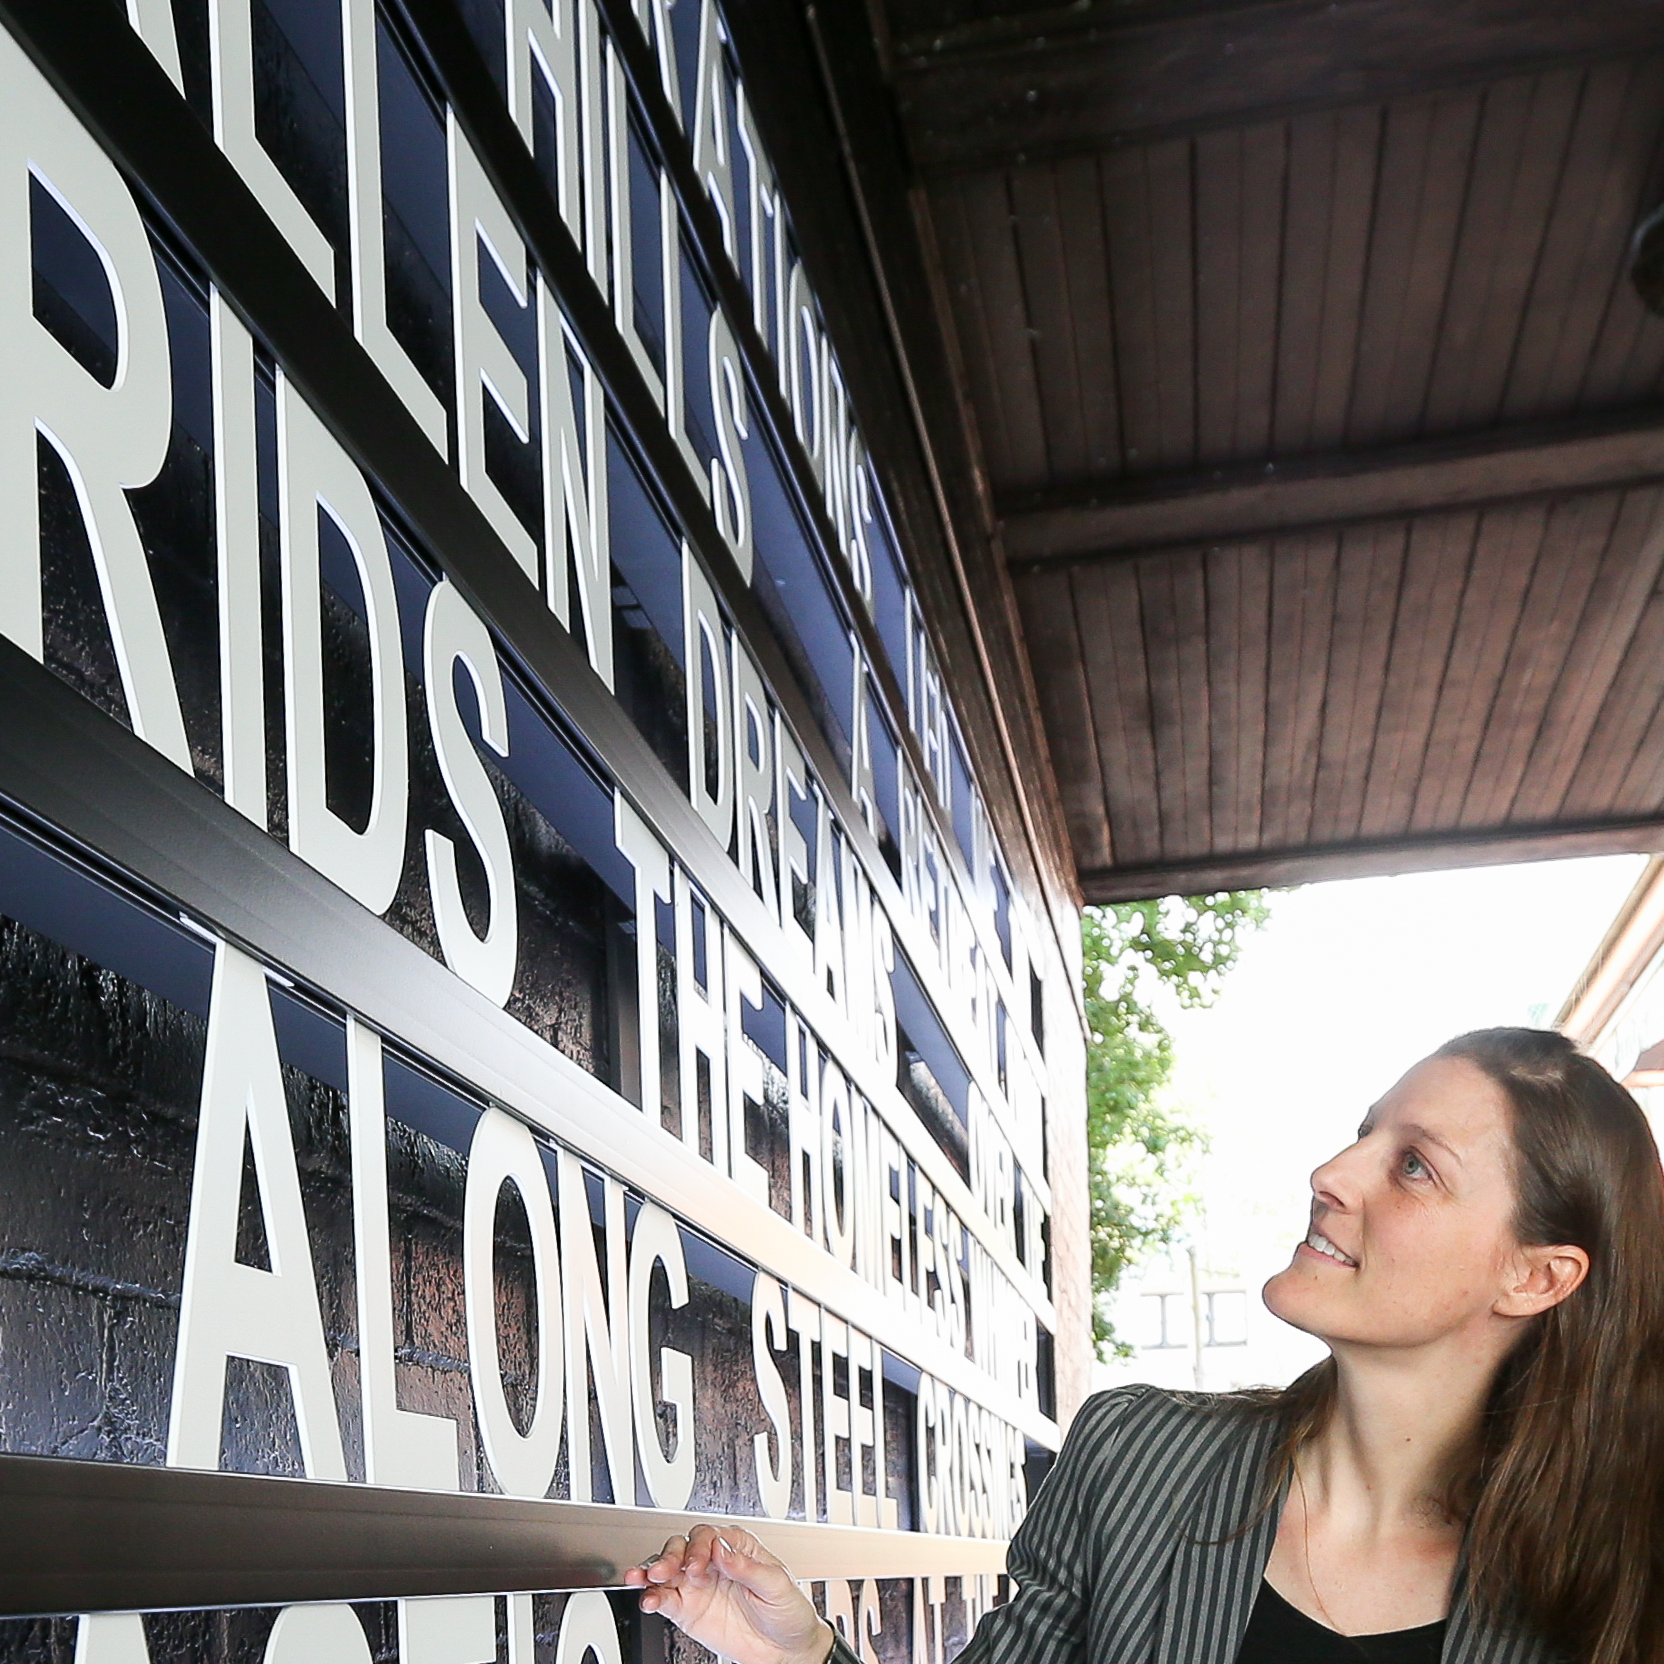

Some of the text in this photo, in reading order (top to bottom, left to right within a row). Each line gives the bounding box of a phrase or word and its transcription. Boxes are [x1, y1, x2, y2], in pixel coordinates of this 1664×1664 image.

[125, 0, 614, 696] LLEN
[682, 536, 898, 1086] DREAMS
[850, 630, 878, 848] A
[904, 584, 951, 820] LED
[166, 940, 1029, 1541] ALONG STEEL CROSSINGS
[613, 786, 770, 1208] THE
[786, 1000, 966, 1353] HOMELESS
